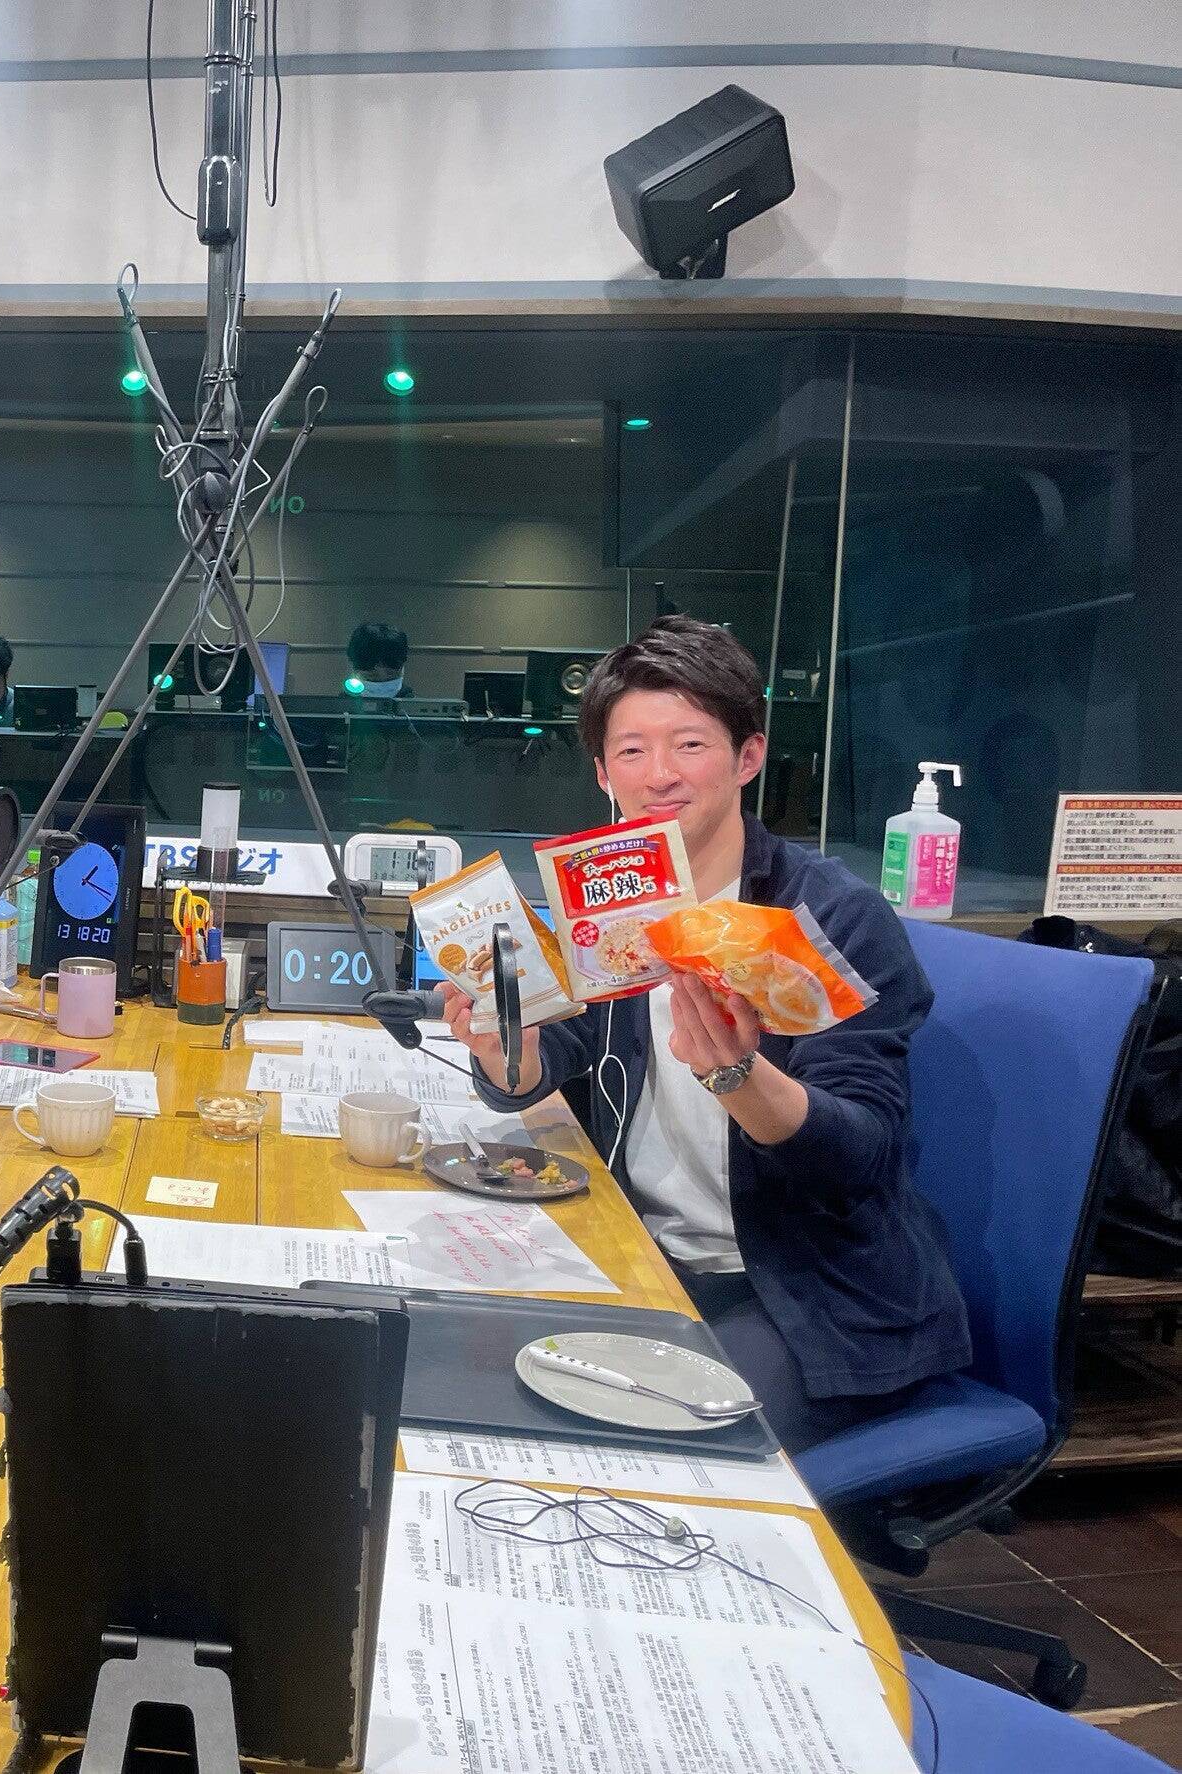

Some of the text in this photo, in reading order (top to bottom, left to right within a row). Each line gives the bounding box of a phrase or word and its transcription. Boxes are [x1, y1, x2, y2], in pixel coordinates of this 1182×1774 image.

[144, 844, 283, 874] TBSジオ
[57, 924, 110, 943] 13 18 20
[284, 948, 373, 985] 0:20
